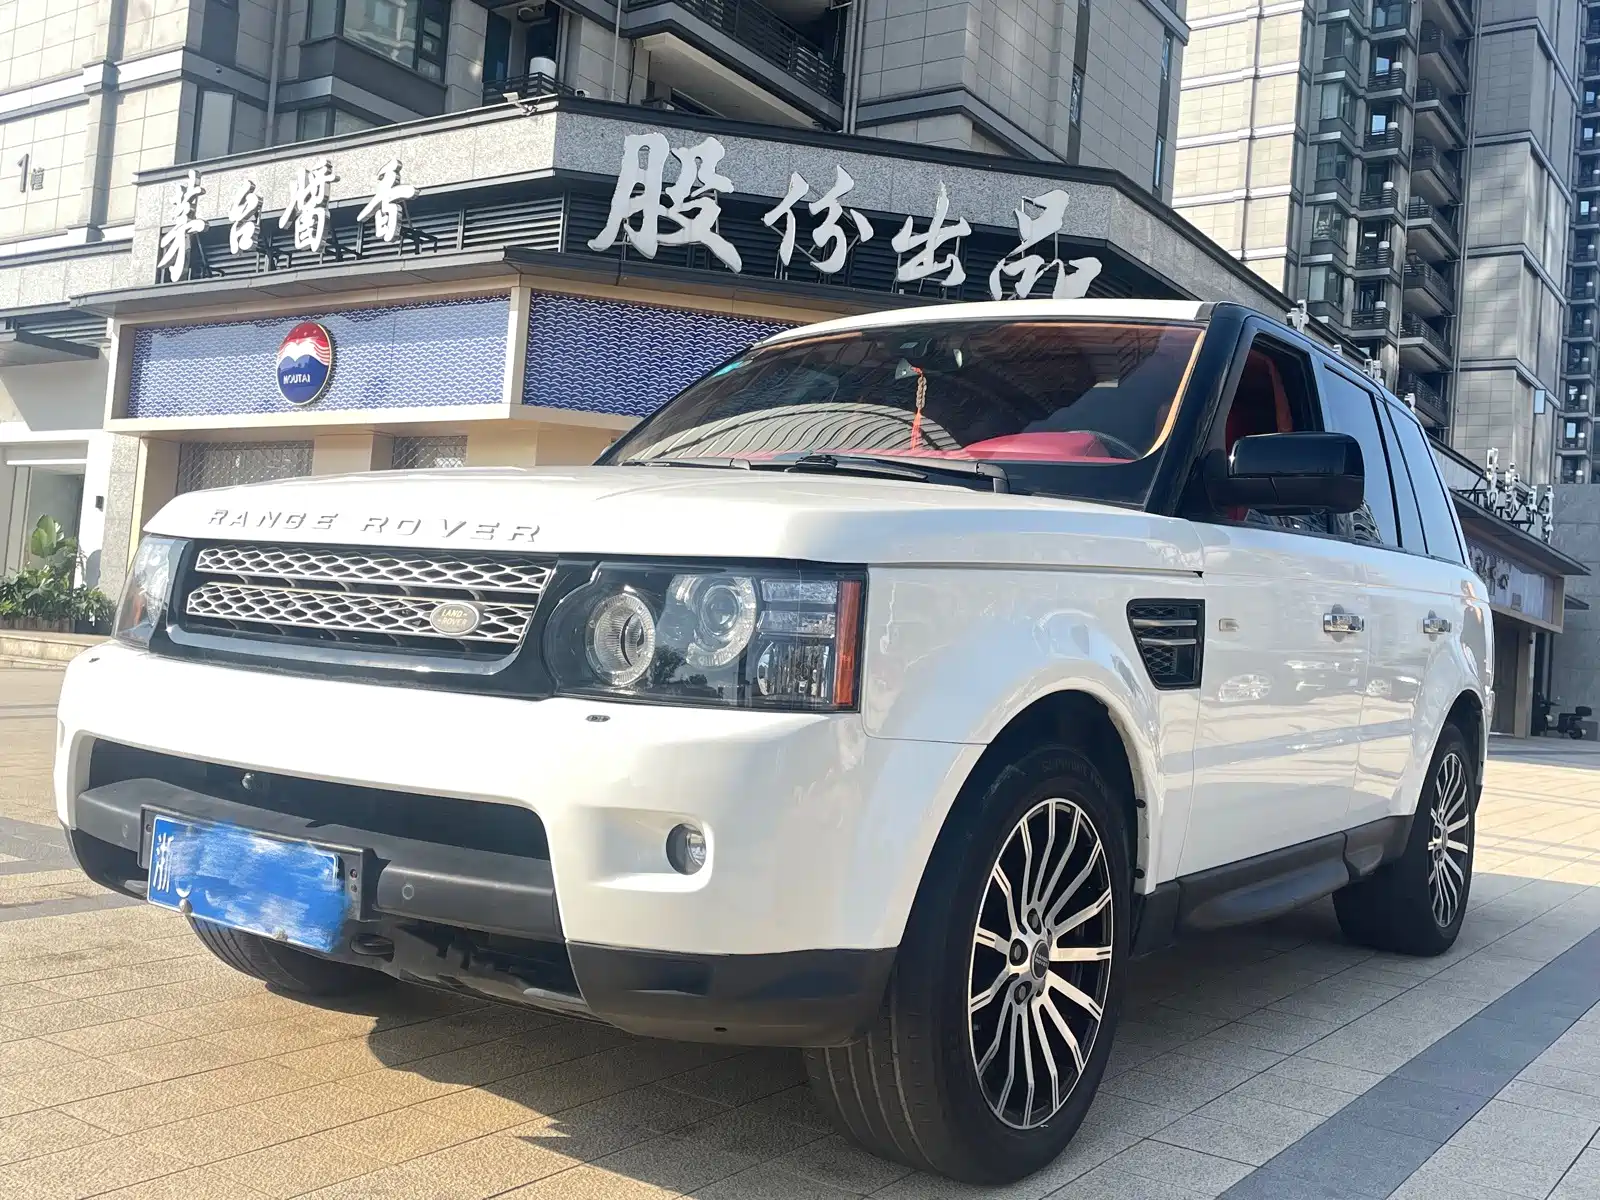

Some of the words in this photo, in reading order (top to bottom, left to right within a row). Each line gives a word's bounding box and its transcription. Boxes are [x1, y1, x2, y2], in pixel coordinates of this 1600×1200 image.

[588, 133, 1102, 300] 股份出品
[283, 373, 311, 385] MOUTAI
[207, 508, 338, 531] RANGE
[360, 513, 541, 544] ROVER
